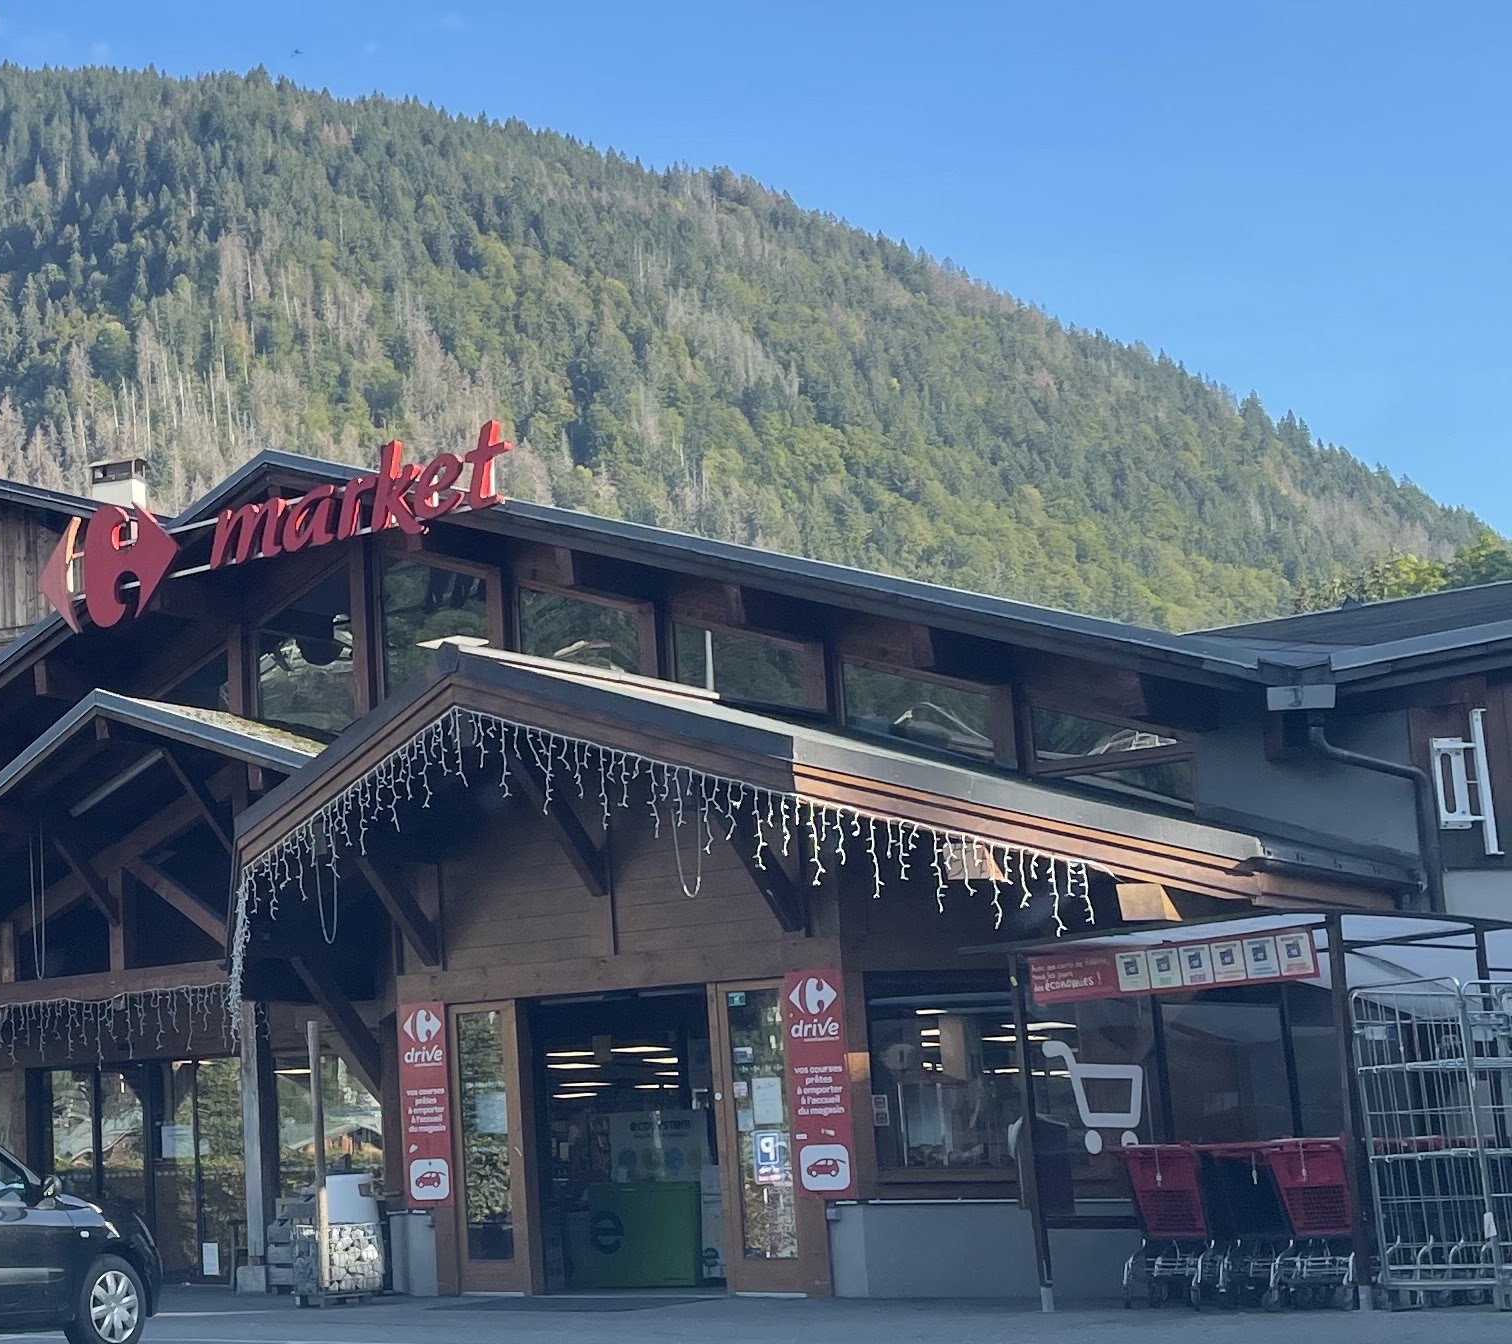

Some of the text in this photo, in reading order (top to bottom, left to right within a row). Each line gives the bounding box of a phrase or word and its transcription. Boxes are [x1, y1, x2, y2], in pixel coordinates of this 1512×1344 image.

[210, 419, 513, 571] market
[791, 1016, 839, 1038] drive
[404, 1045, 443, 1063] drive
[803, 1086, 843, 1095] emporter
[798, 1105, 845, 1116] du magasin
[630, 1120, 691, 1131] ecostem
